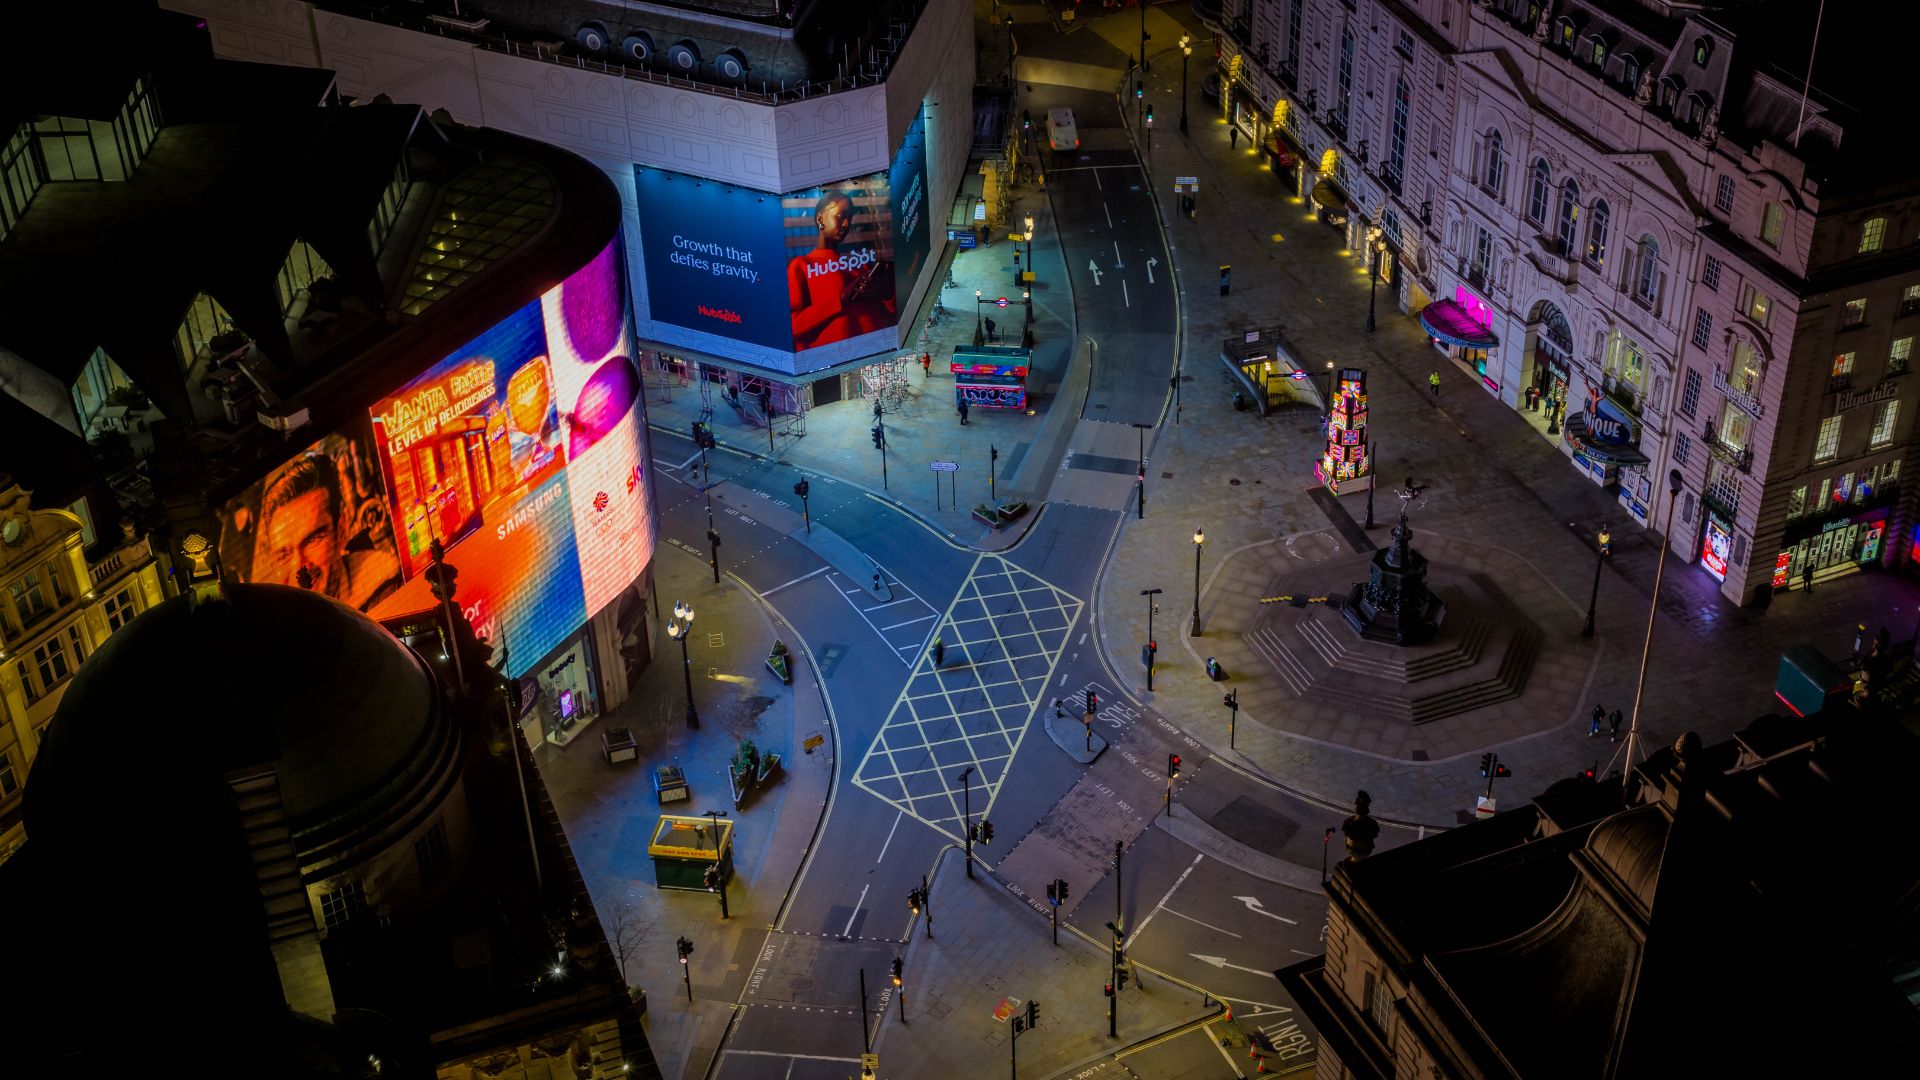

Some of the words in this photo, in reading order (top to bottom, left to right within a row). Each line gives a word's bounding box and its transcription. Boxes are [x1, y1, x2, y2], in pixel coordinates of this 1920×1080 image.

[673, 235, 723, 257] Growth
[726, 246, 753, 264] that
[807, 247, 876, 279] HubSpot
[670, 251, 709, 271] defies
[712, 262, 760, 284] gravity.
[698, 305, 742, 324] HubSpot
[381, 387, 448, 437] WANTA
[1835, 381, 1899, 415] Lillywhites
[388, 427, 423, 457] LEVEL
[424, 419, 438, 434] UP
[439, 383, 496, 426] DELICIOUSNESS
[626, 458, 644, 495] sky
[496, 482, 562, 541] SAMSUNG
[1096, 701, 1142, 729] BUS
[1162, 720, 1181, 735] RIGHT
[1183, 736, 1201, 749] LOOK
[1121, 751, 1140, 767] LOOK
[1142, 768, 1162, 783] LEFT
[1095, 783, 1115, 798] LEFT
[1116, 799, 1135, 814] LOOK
[1006, 882, 1024, 897] LOOK
[1027, 898, 1050, 915] RIGHT
[762, 944, 777, 962] LOOK
[751, 967, 767, 989] RIGHT
[881, 987, 893, 1007] LOOK
[1075, 1066, 1100, 1080] LOOK
